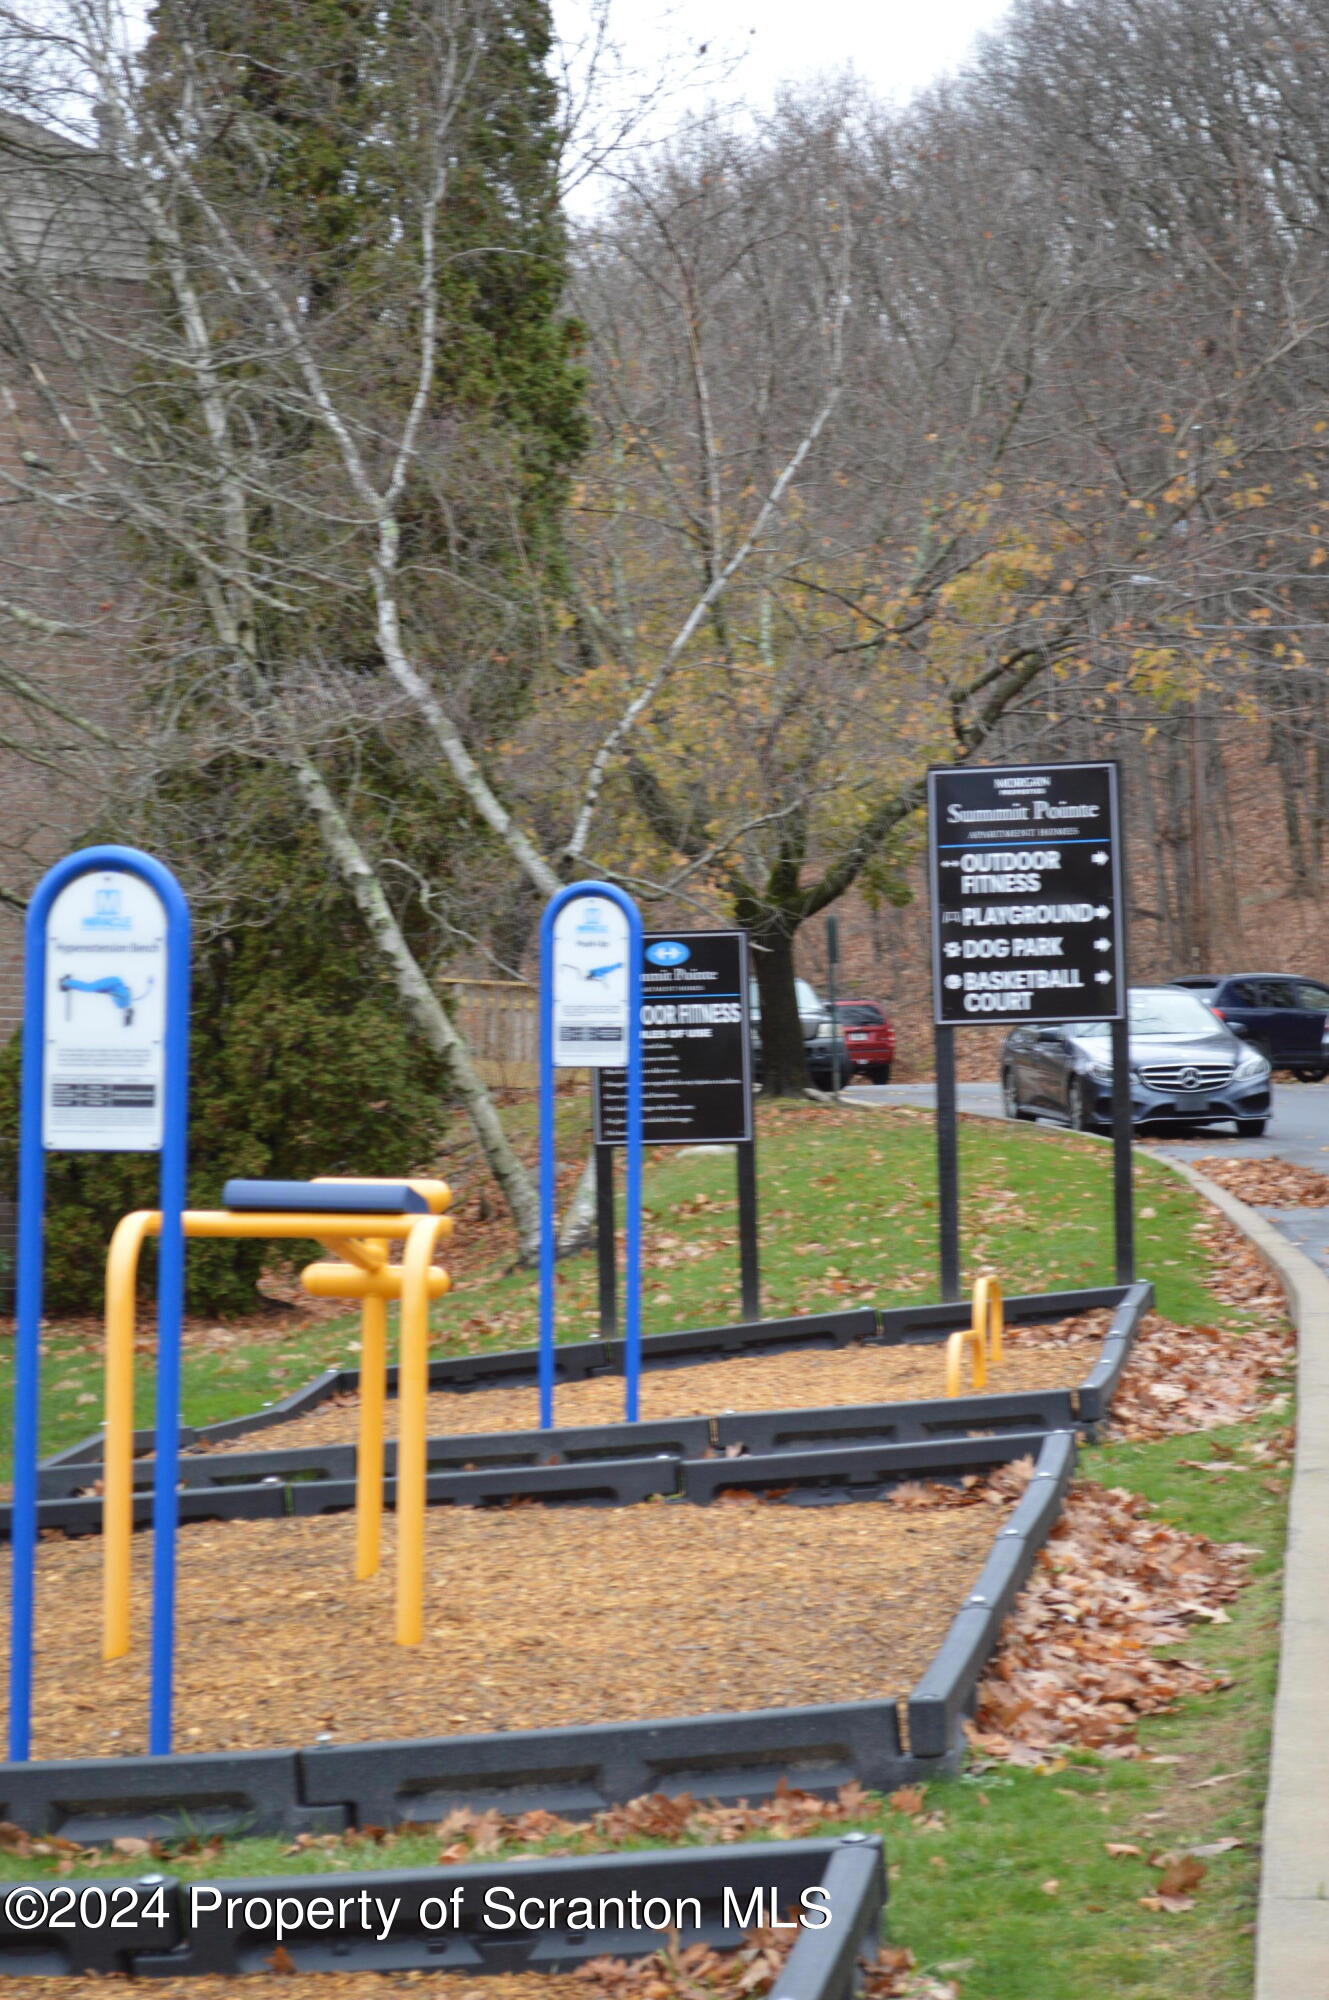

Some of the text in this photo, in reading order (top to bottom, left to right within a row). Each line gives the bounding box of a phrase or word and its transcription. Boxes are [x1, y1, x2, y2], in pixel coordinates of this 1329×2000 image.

[947, 801, 1100, 823] Summit Pointe
[960, 851, 1062, 872] OUTDOOR
[961, 873, 1042, 894] FITNESS
[962, 903, 1094, 926] PLAYGROUND
[963, 937, 1064, 959] DOG PARK
[963, 969, 1085, 991] BASKETBALL
[677, 1002, 742, 1024] FITNESS
[963, 992, 1034, 1012] COURT
